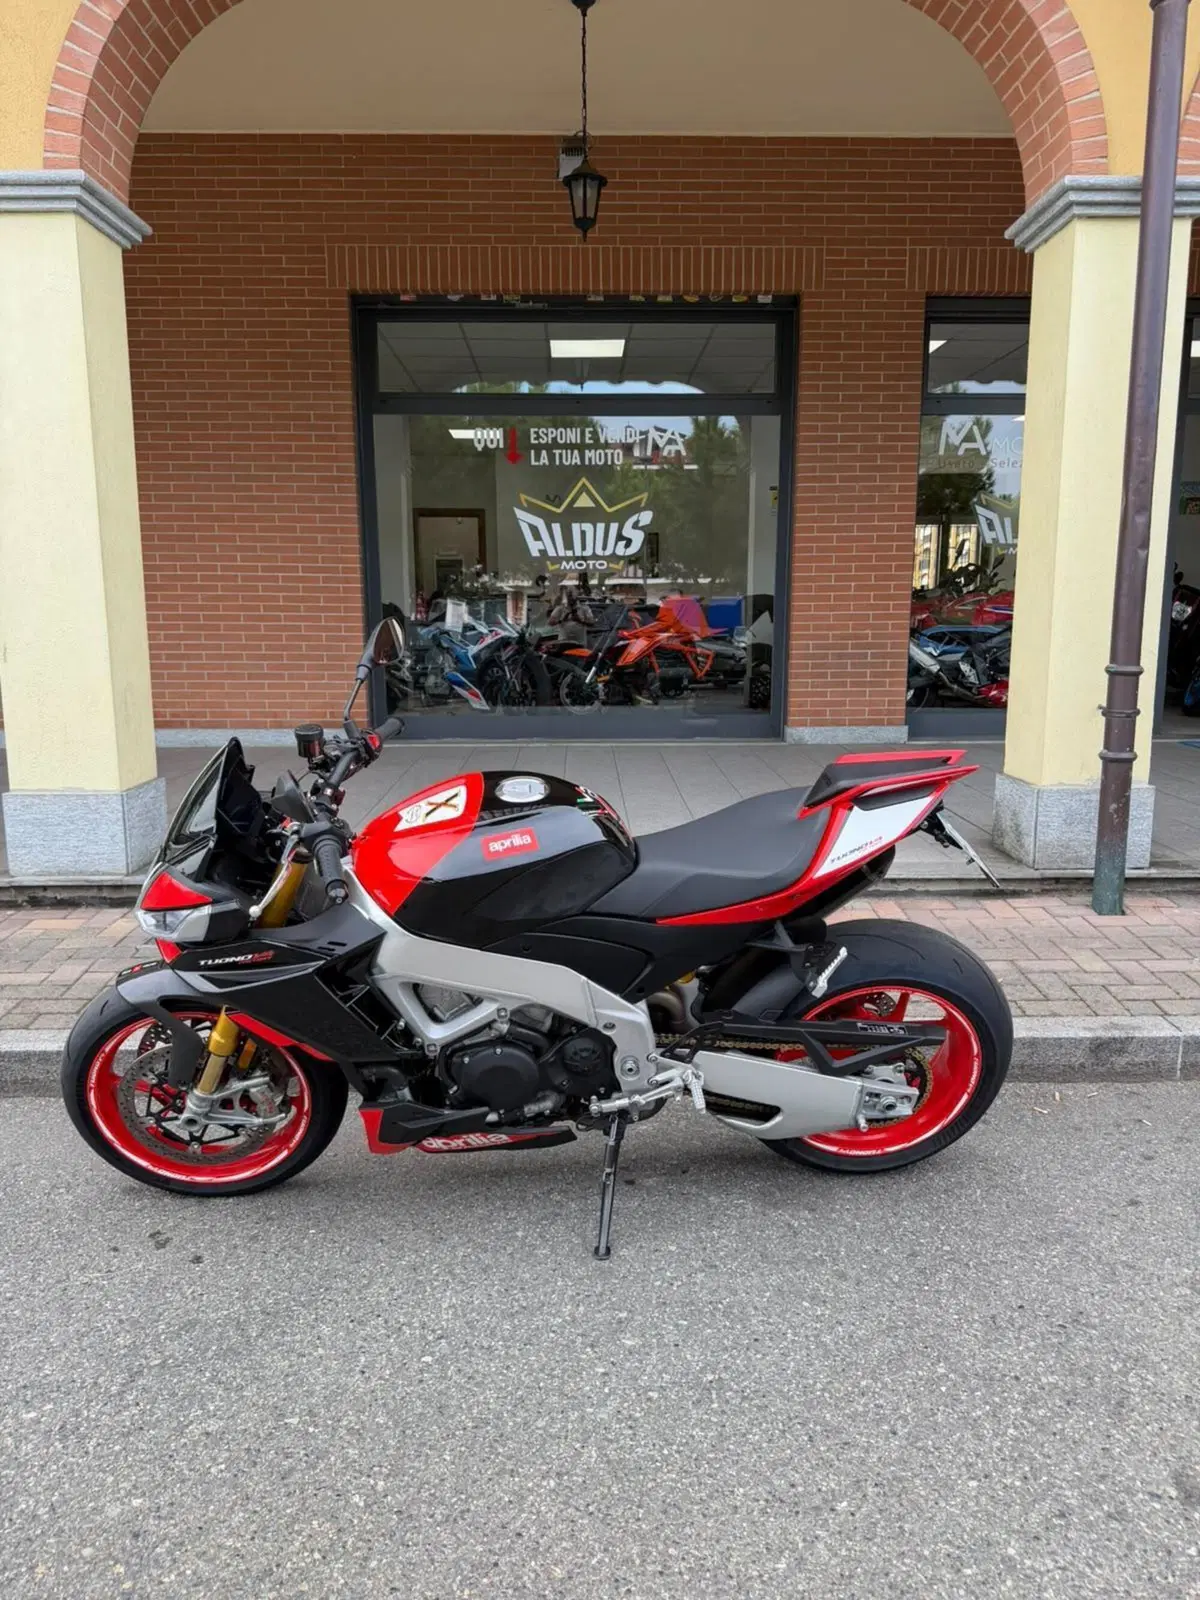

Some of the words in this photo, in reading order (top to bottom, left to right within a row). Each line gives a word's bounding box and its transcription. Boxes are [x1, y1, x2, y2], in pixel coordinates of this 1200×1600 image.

[473, 427, 504, 451] QUI
[530, 427, 581, 444] ESPONI
[585, 427, 593, 444] E
[599, 427, 640, 444] VENDI
[530, 450, 549, 466] LA
[553, 450, 581, 466] TUA
[585, 449, 623, 466] MOTO
[513, 506, 654, 557] ALDUS
[560, 560, 608, 570] MOTO
[488, 833, 532, 853] aprilia
[199, 954, 253, 966] TUONO
[422, 1133, 511, 1150] aprilia
